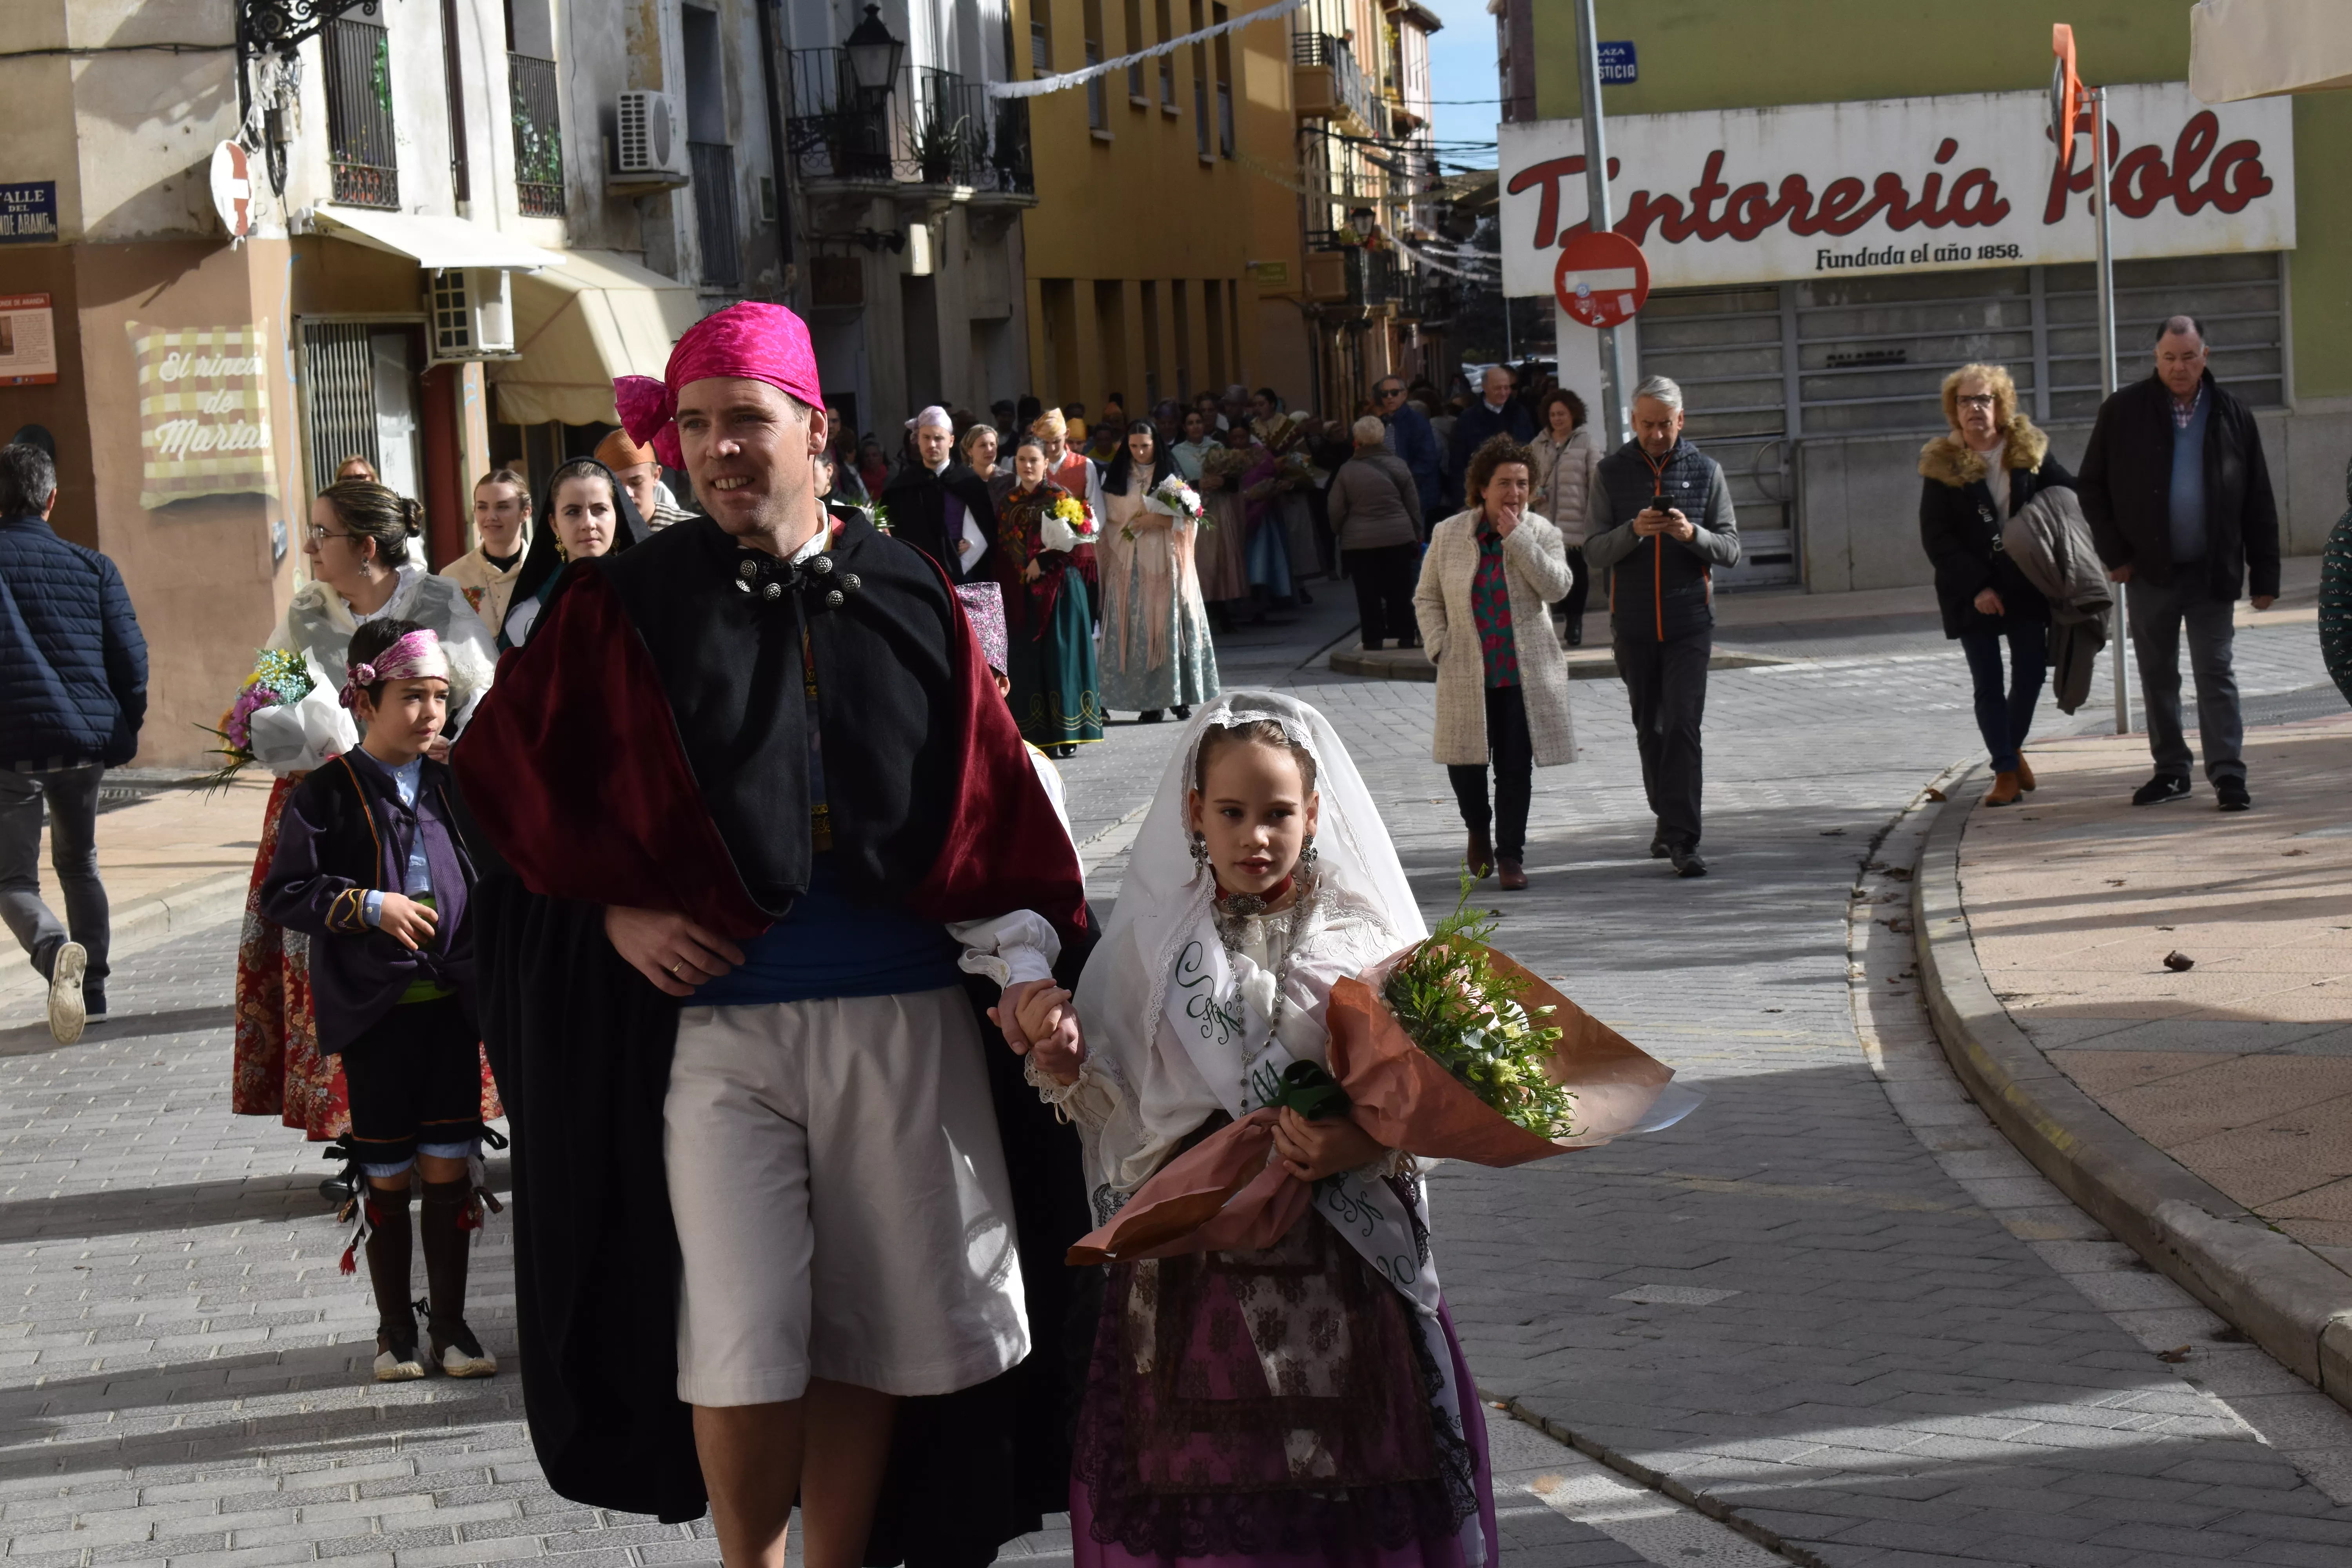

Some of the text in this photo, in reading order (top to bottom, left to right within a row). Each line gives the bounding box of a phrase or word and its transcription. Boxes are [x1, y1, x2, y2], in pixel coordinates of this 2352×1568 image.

[1598, 48, 1625, 56] LAZA
[1598, 64, 1635, 80] STICIA
[2043, 110, 2273, 225] Polo
[0, 190, 45, 203] ALLE
[8, 204, 30, 212] DEL
[1816, 243, 2023, 270] Fundada el año 1858.
[159, 351, 263, 382] El rincó
[203, 388, 234, 414] de
